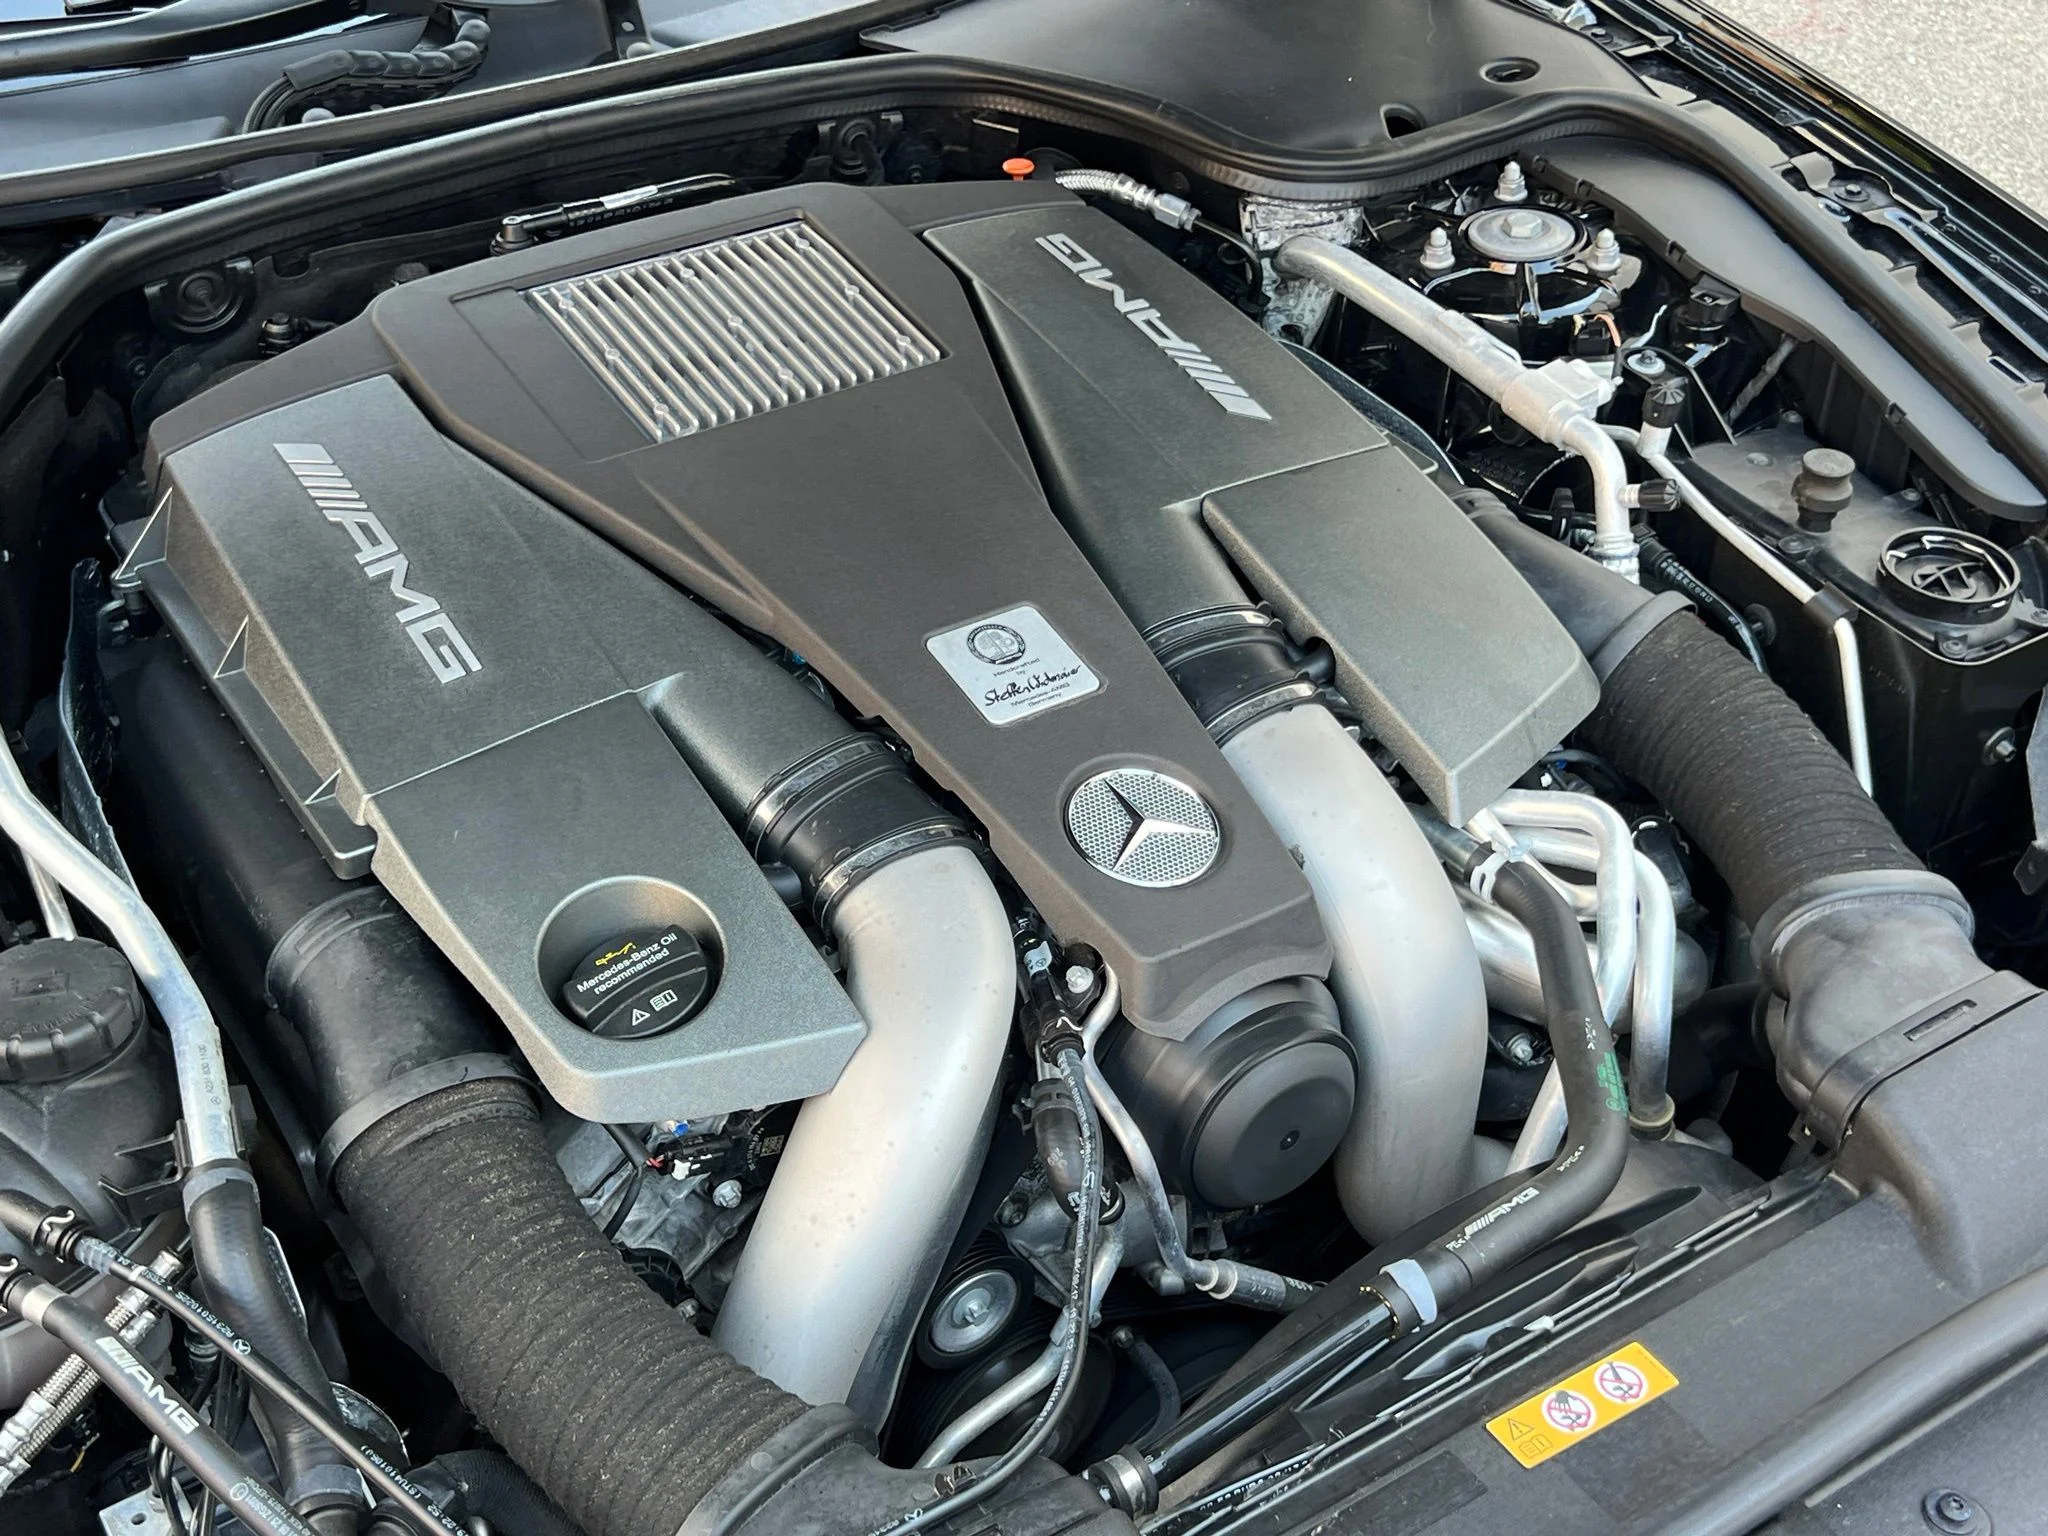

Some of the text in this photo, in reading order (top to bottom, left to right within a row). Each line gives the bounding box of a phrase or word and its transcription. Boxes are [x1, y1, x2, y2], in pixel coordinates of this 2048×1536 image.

[322, 508, 483, 685] AMG
[992, 657, 1040, 677] Handcrafted
[577, 932, 678, 993] Mercedes-Benz Oil
[593, 947, 670, 995] recommended
